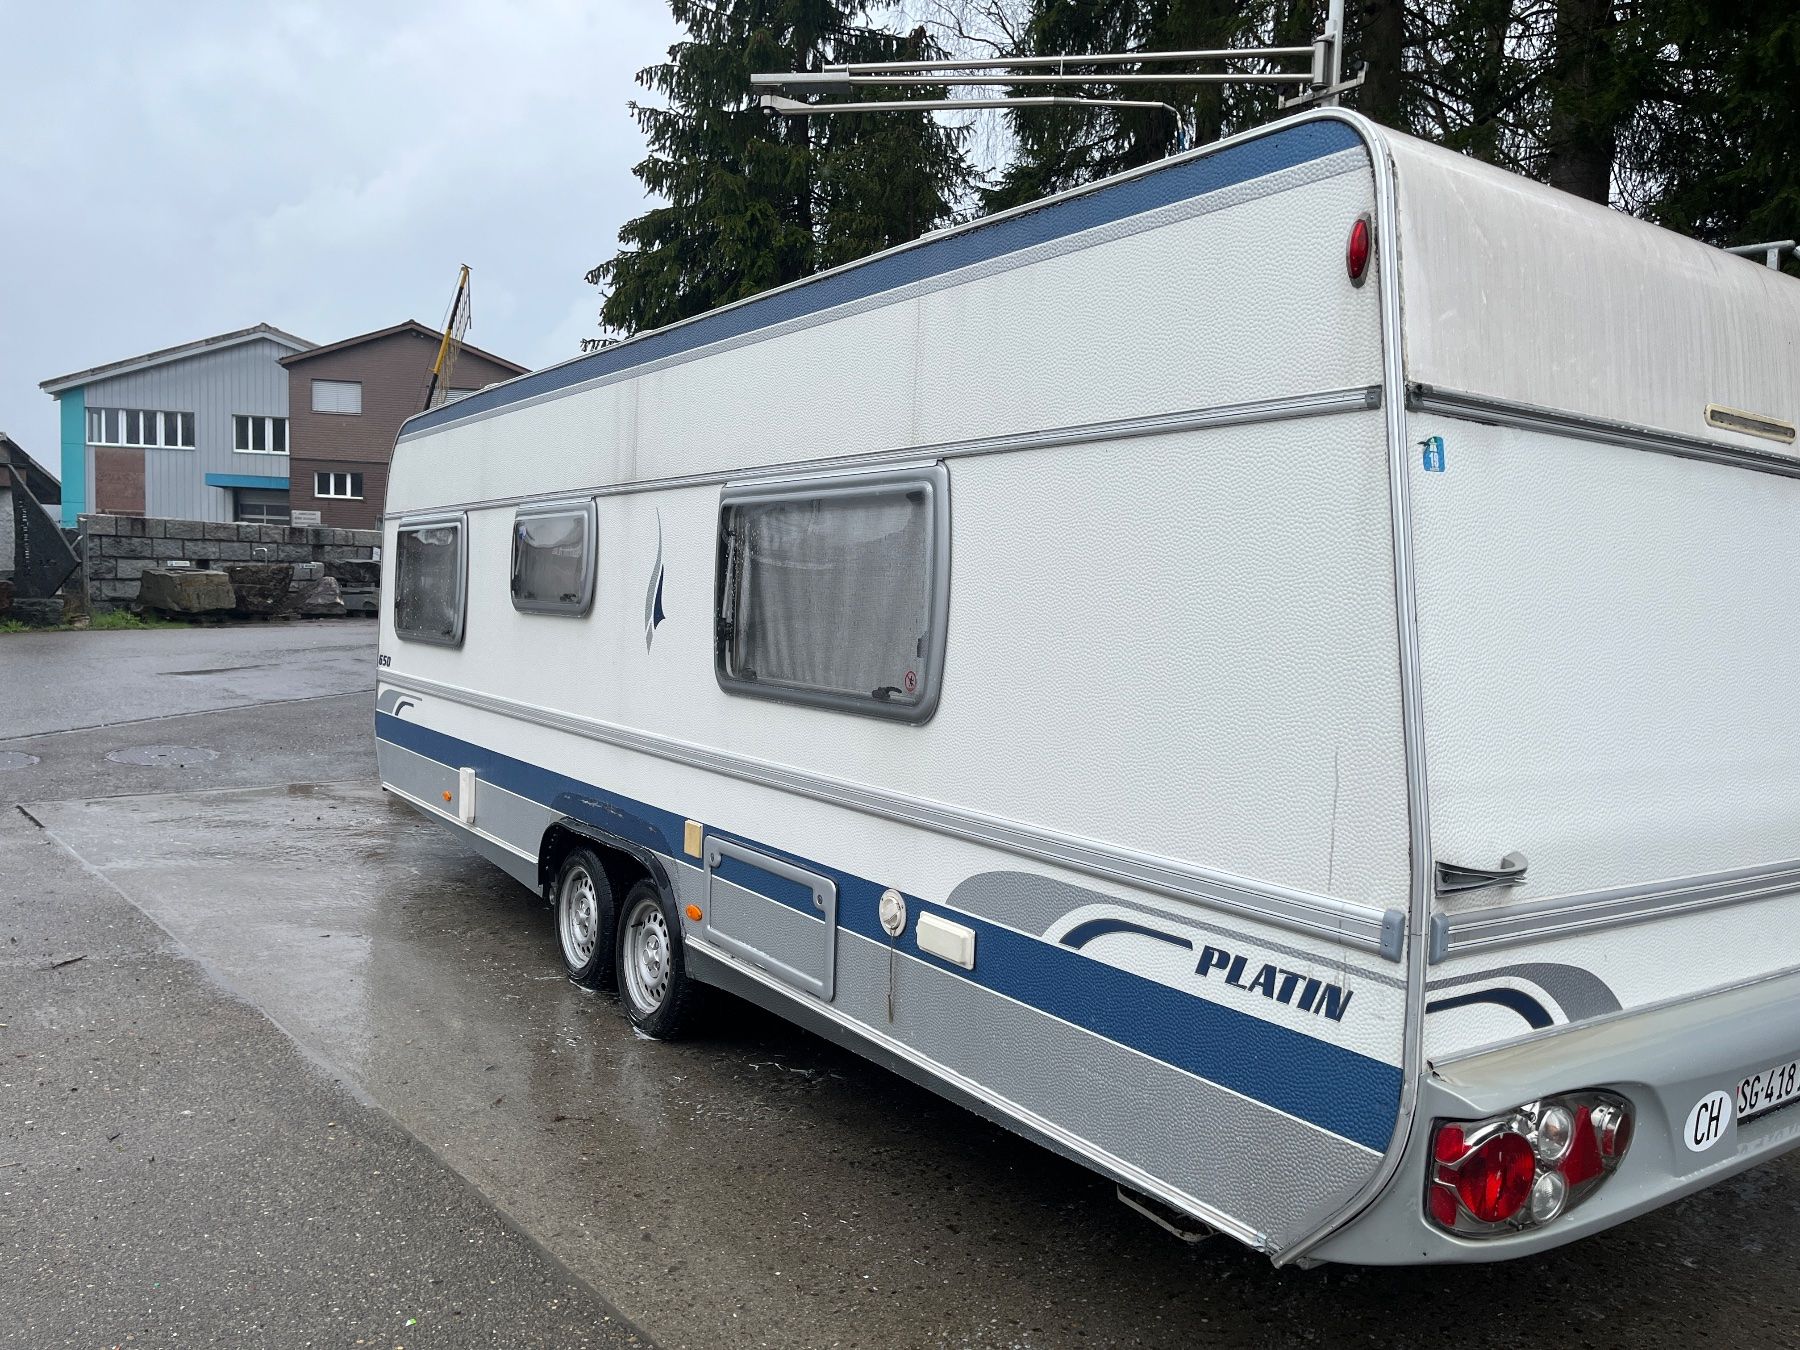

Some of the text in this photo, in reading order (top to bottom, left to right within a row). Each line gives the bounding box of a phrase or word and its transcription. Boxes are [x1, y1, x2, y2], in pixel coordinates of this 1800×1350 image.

[378, 654, 392, 668] 650
[1195, 945, 1354, 1022] PLATIN
[1693, 1096, 1724, 1146] CH
